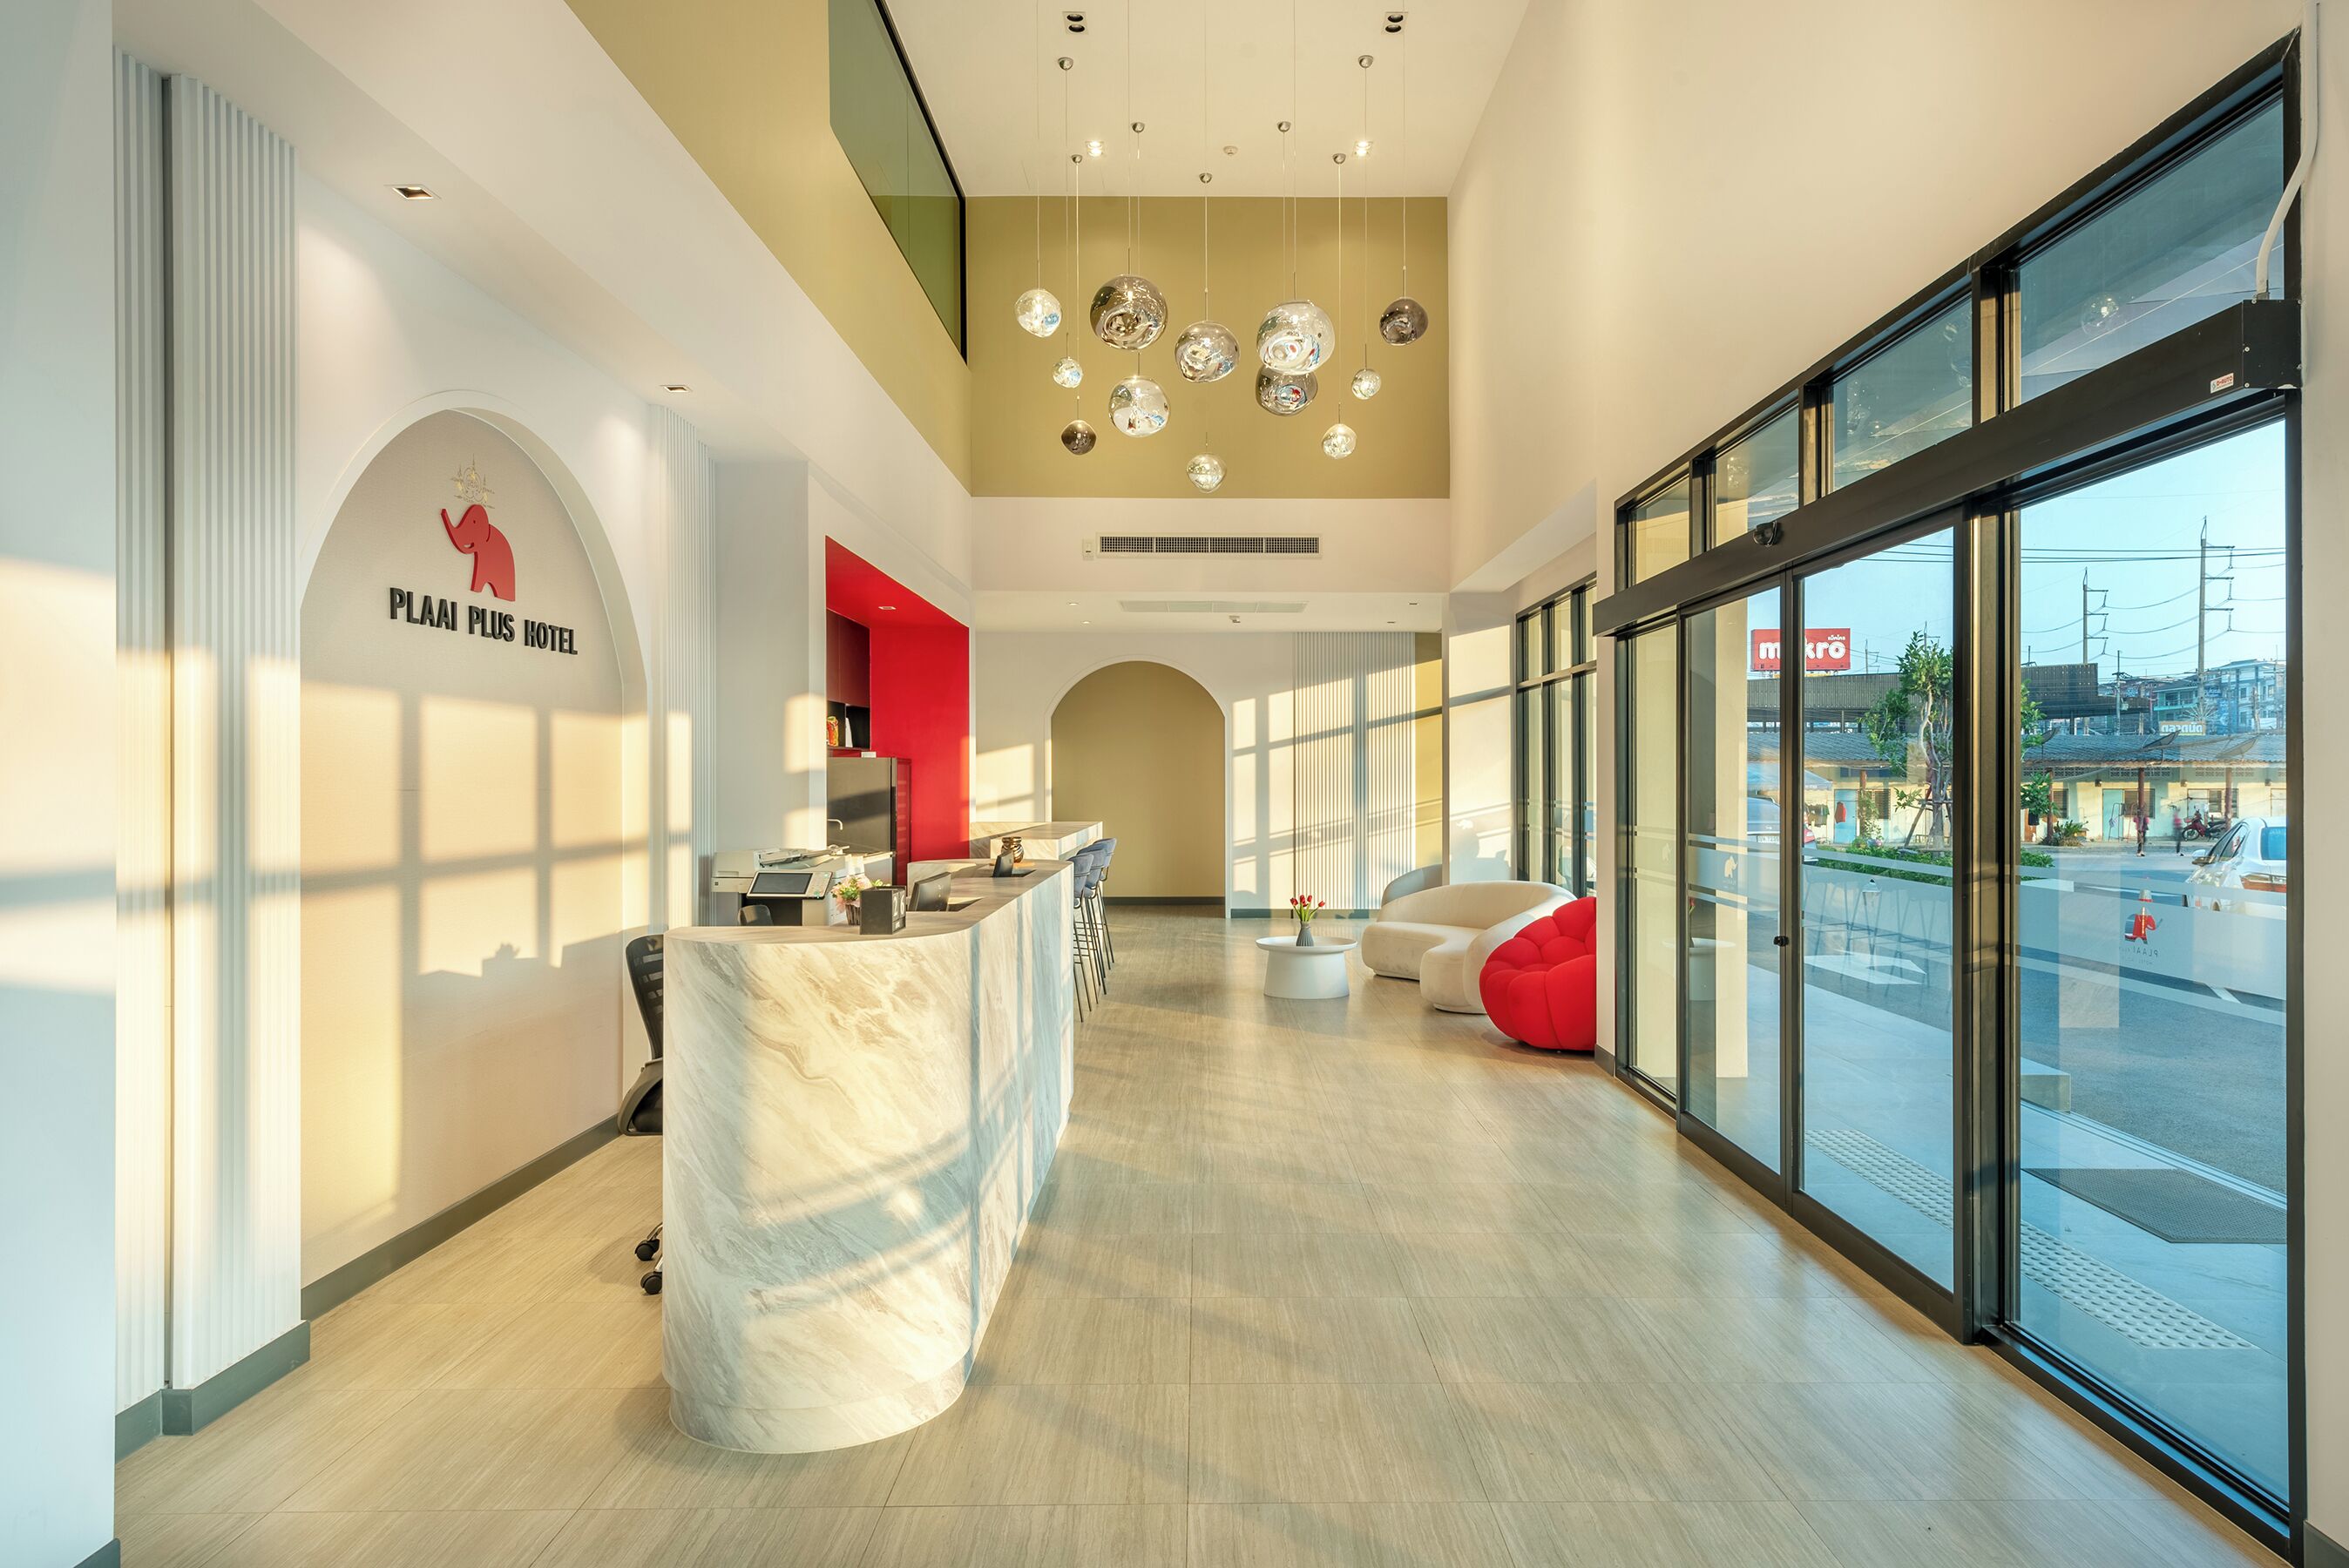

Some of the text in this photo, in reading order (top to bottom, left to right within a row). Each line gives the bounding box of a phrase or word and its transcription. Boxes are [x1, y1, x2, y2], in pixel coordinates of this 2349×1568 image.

[389, 587, 578, 655] PLAAI PLUS HOTEL
[1758, 636, 1846, 659] mkro
